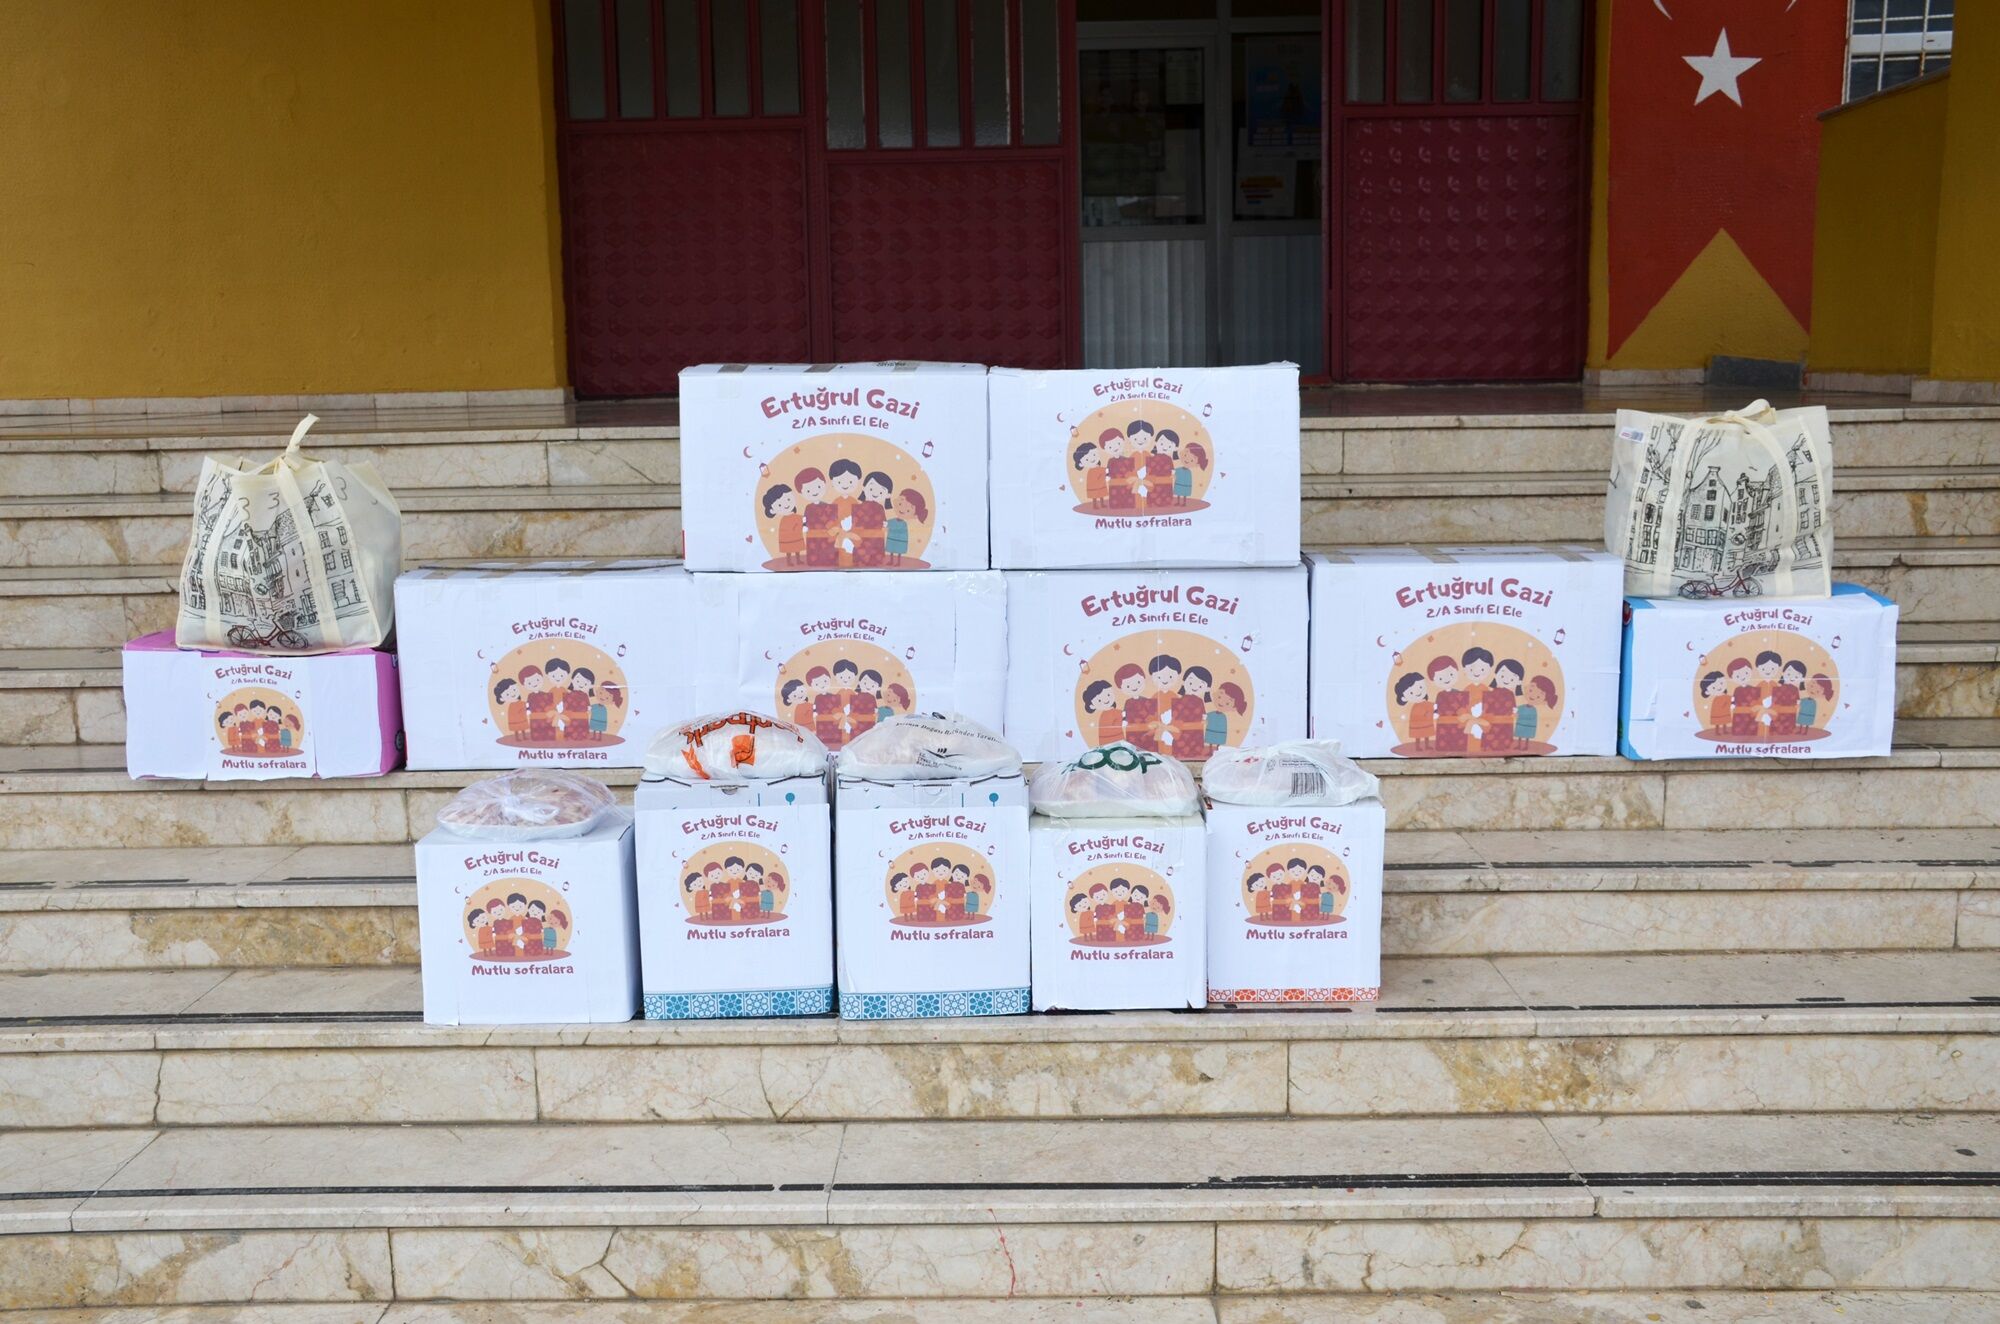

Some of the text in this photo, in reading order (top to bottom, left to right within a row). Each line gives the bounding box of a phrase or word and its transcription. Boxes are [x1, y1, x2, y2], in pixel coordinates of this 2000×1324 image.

[1093, 376, 1184, 397] Ertuğrul Gazi
[761, 386, 921, 420] Ertuğrul Gazi
[791, 415, 890, 431] 2/A Sınıfı El Ele
[1095, 516, 1193, 530] Mutlu sofralara
[1081, 584, 1240, 618] Ertuğrul Gazi
[1396, 577, 1554, 609] Ertuğrul Gazi
[1112, 612, 1209, 627] 2/A Sınıfı El Ele
[1427, 604, 1523, 619] 2/A Sınıfı El Ele
[1724, 607, 1813, 627] Ertuğrul Gazi
[512, 616, 599, 635] Ertuğrul Gazi
[800, 616, 888, 637] Ertuğrul Gazi
[215, 663, 293, 680] Ertuğrul Gazi
[518, 749, 553, 760] Mutlu
[1715, 744, 1812, 756] Mutlu sofralara
[222, 758, 307, 770] Mutlu sofralara
[681, 815, 778, 835] Ertuğrul Gazi
[889, 815, 987, 835] Ertuğrul Gazi
[1246, 816, 1343, 836] Ertuğrul Gazi
[1068, 836, 1165, 856] Ertuğrul Gazi
[464, 850, 560, 871] Ertuğrul Gazi
[687, 927, 790, 940] Mutlu sofralara
[890, 928, 994, 941] Mutlu sofralara
[1246, 928, 1348, 941] Mutlu sofralara
[1070, 948, 1174, 961] Mutlu sofralara
[471, 963, 574, 976] Mutlu sofralara
